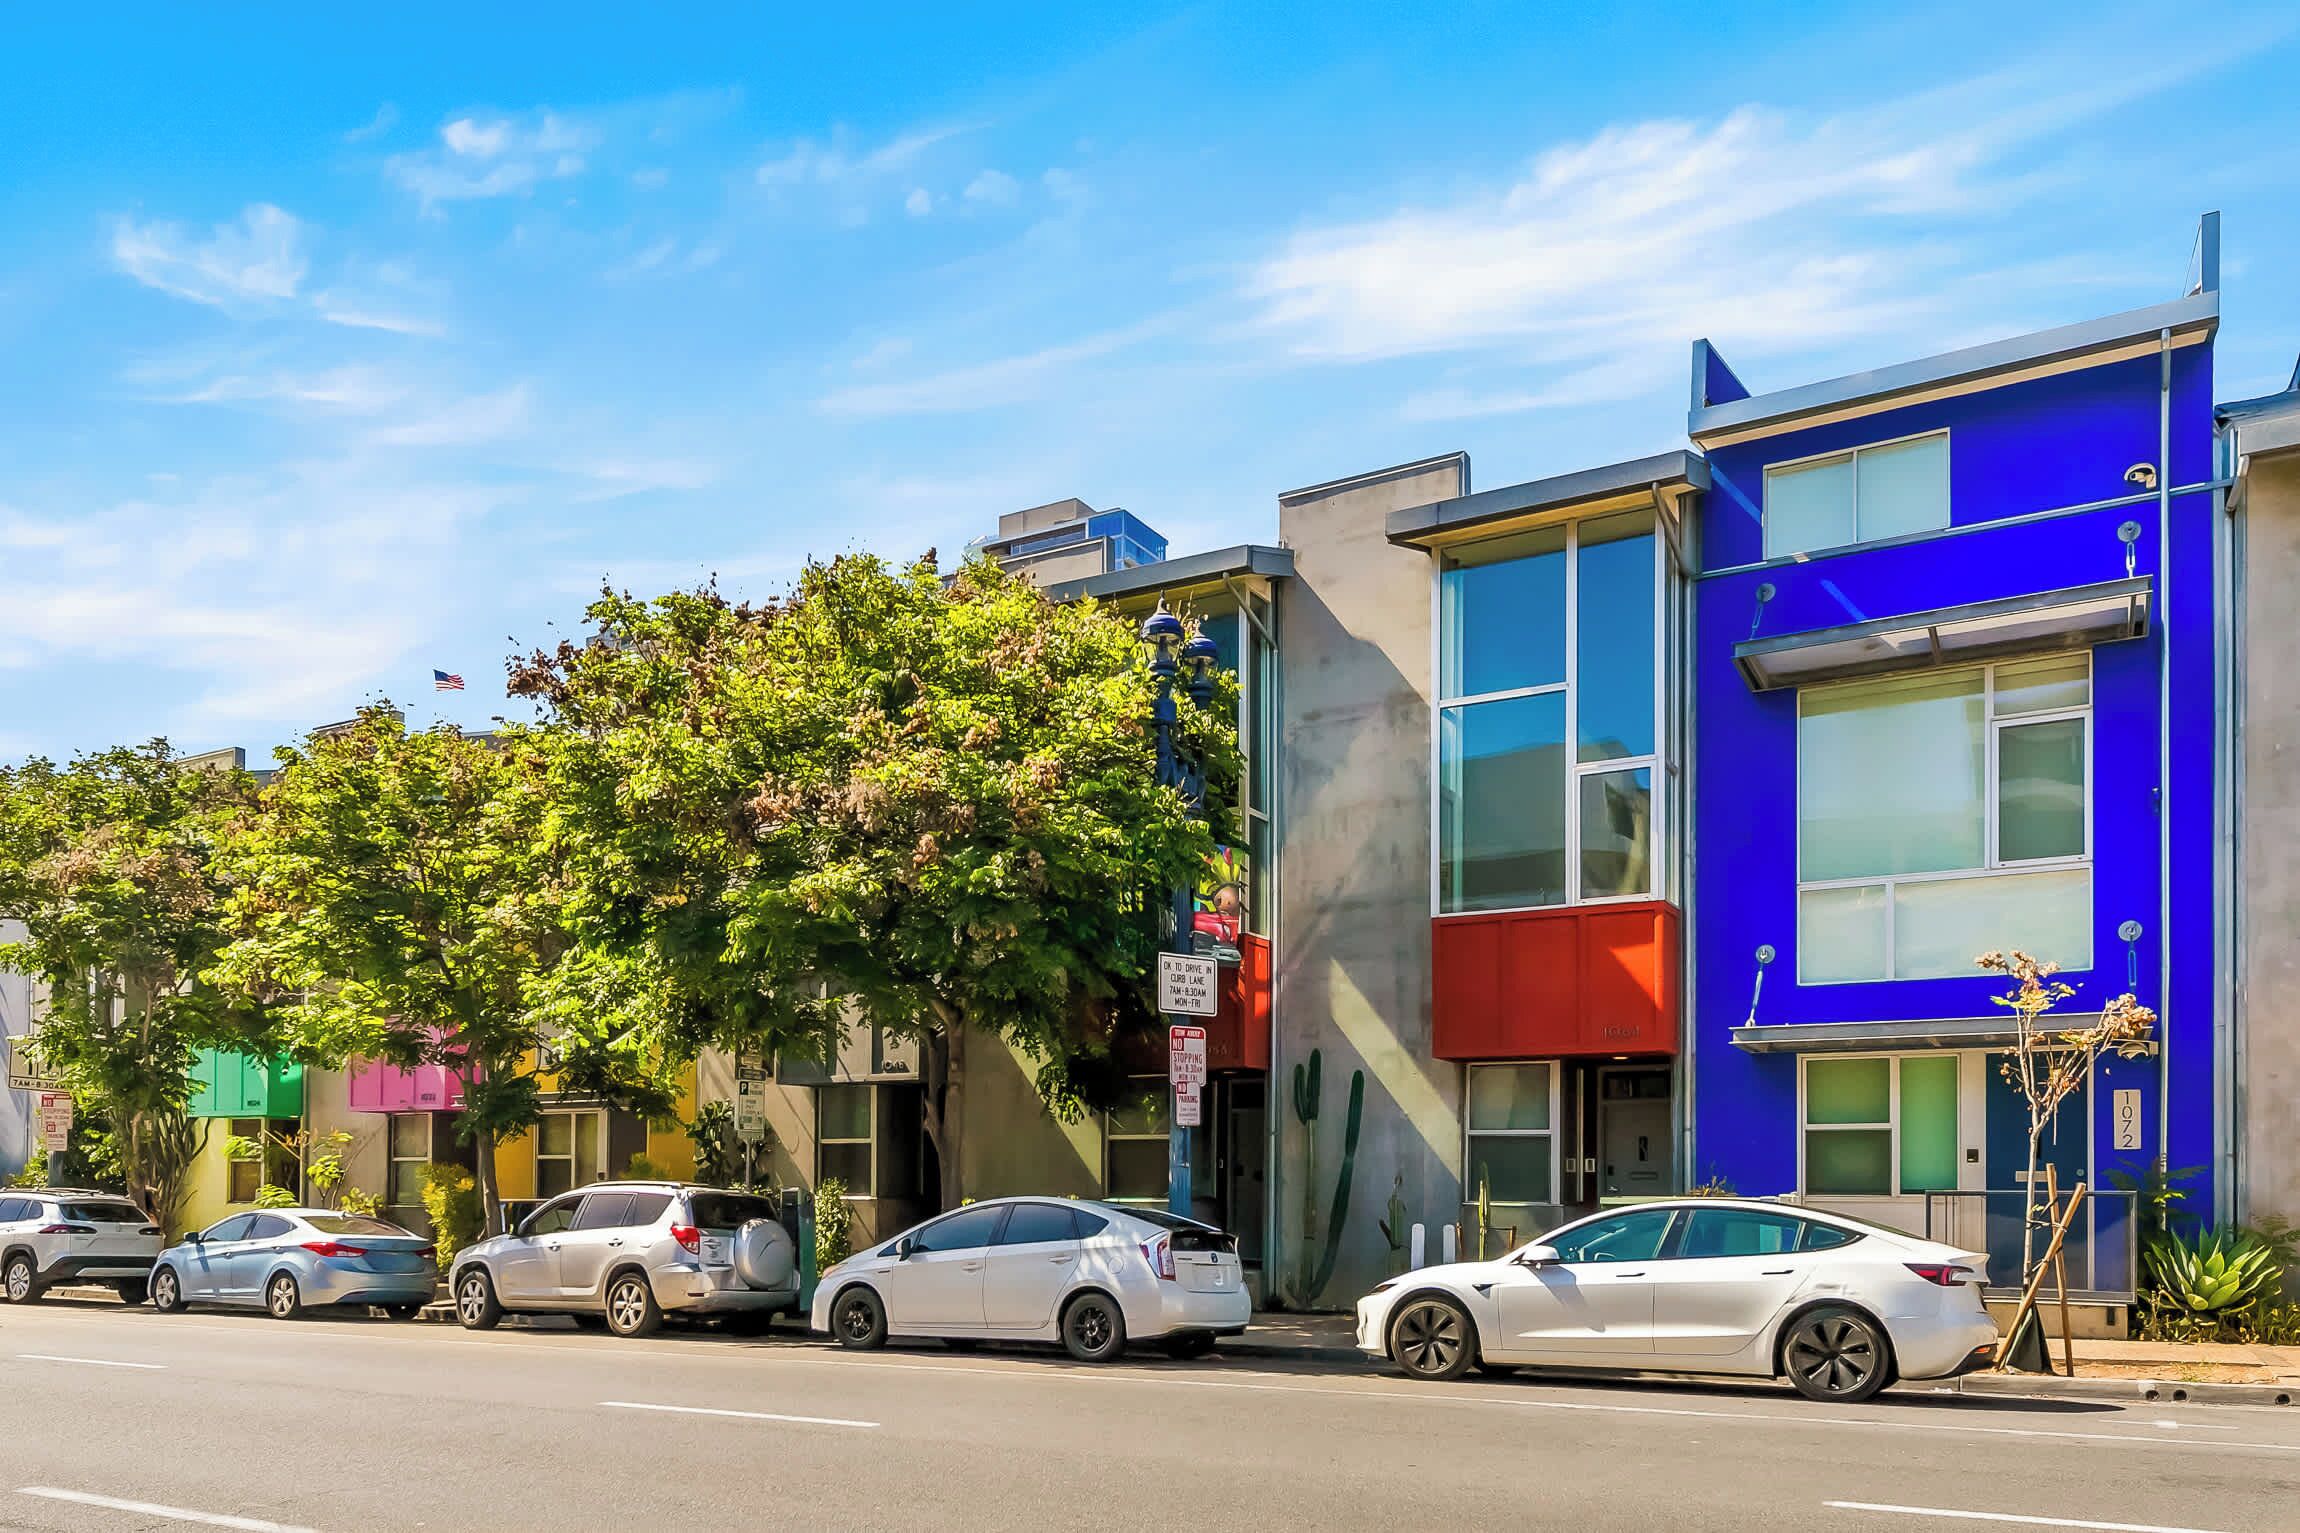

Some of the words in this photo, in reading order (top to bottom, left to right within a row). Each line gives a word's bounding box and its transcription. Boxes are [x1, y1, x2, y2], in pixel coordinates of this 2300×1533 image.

[1164, 961, 1171, 970] OK
[1175, 962, 1182, 972] TO
[1185, 963, 1202, 974] DRIVE
[1206, 966, 1212, 975] IN
[1170, 973, 1186, 984] CURB
[1189, 975, 1205, 986] LANE
[1174, 997, 1201, 1008] MON-FRI
[1172, 1038, 1183, 1050] NO
[1173, 1052, 1203, 1065] STOPPING
[2122, 1091, 2133, 1148] 1072
